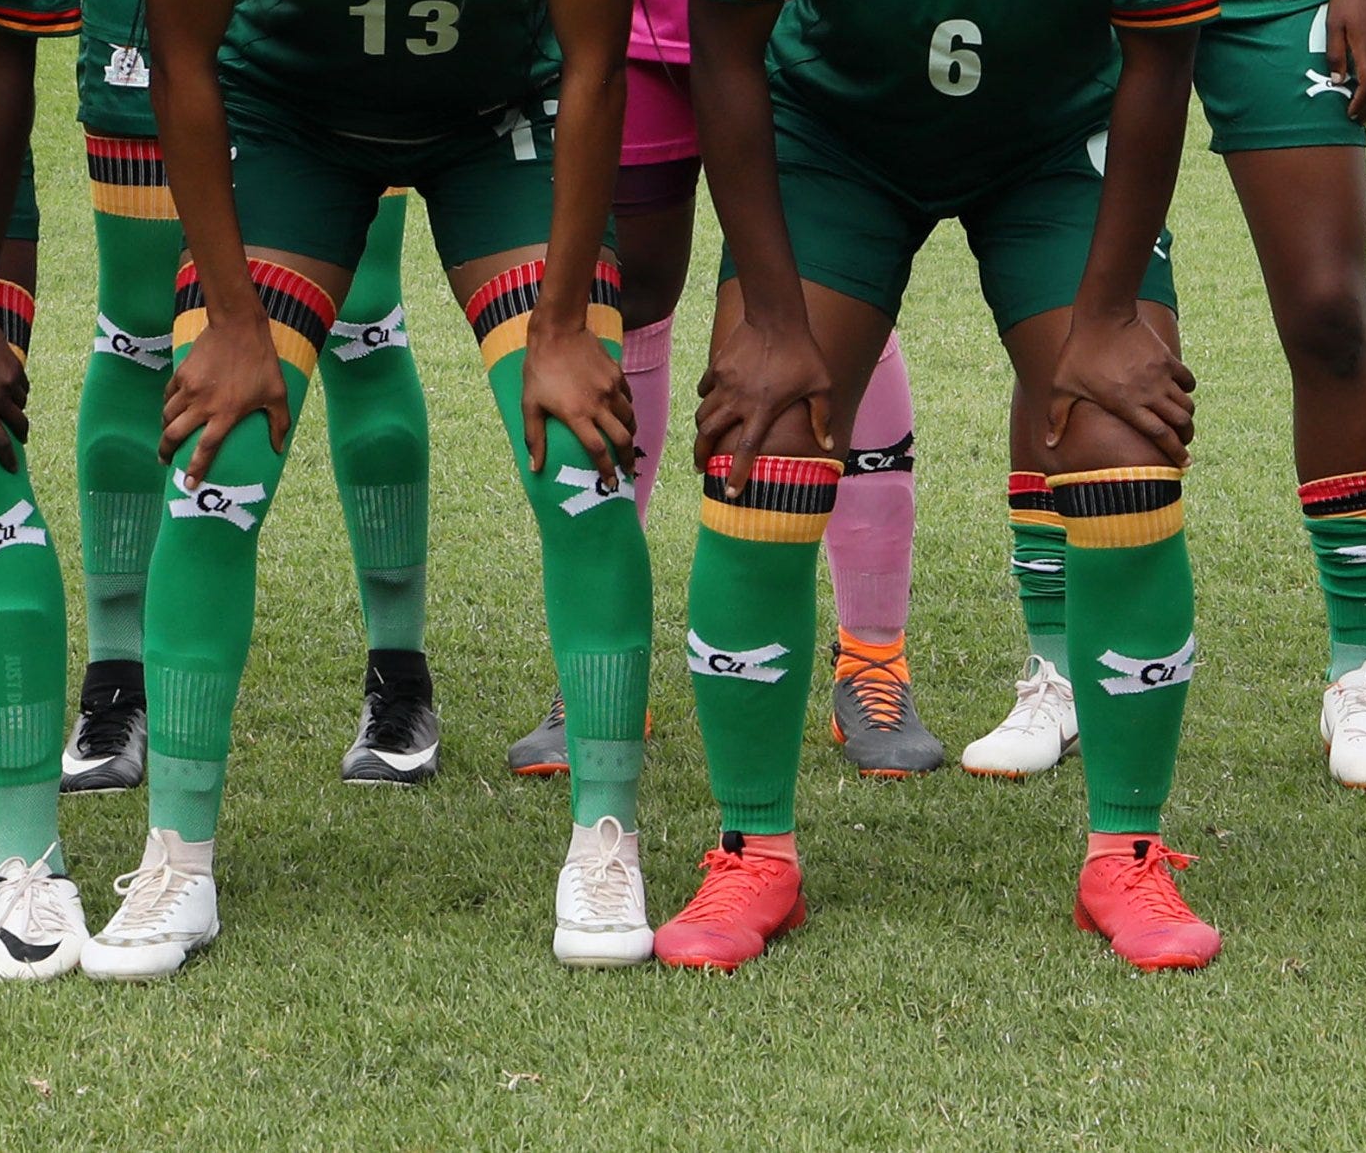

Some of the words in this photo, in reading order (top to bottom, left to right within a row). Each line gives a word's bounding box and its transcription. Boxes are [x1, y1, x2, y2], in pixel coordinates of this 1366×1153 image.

[928, 19, 983, 96] 6
[112, 334, 140, 356] Cu
[362, 326, 389, 346] Cu
[857, 452, 894, 471] Cu
[196, 488, 232, 513] Cu
[709, 654, 746, 674] Cu
[1140, 663, 1176, 685] Cu
